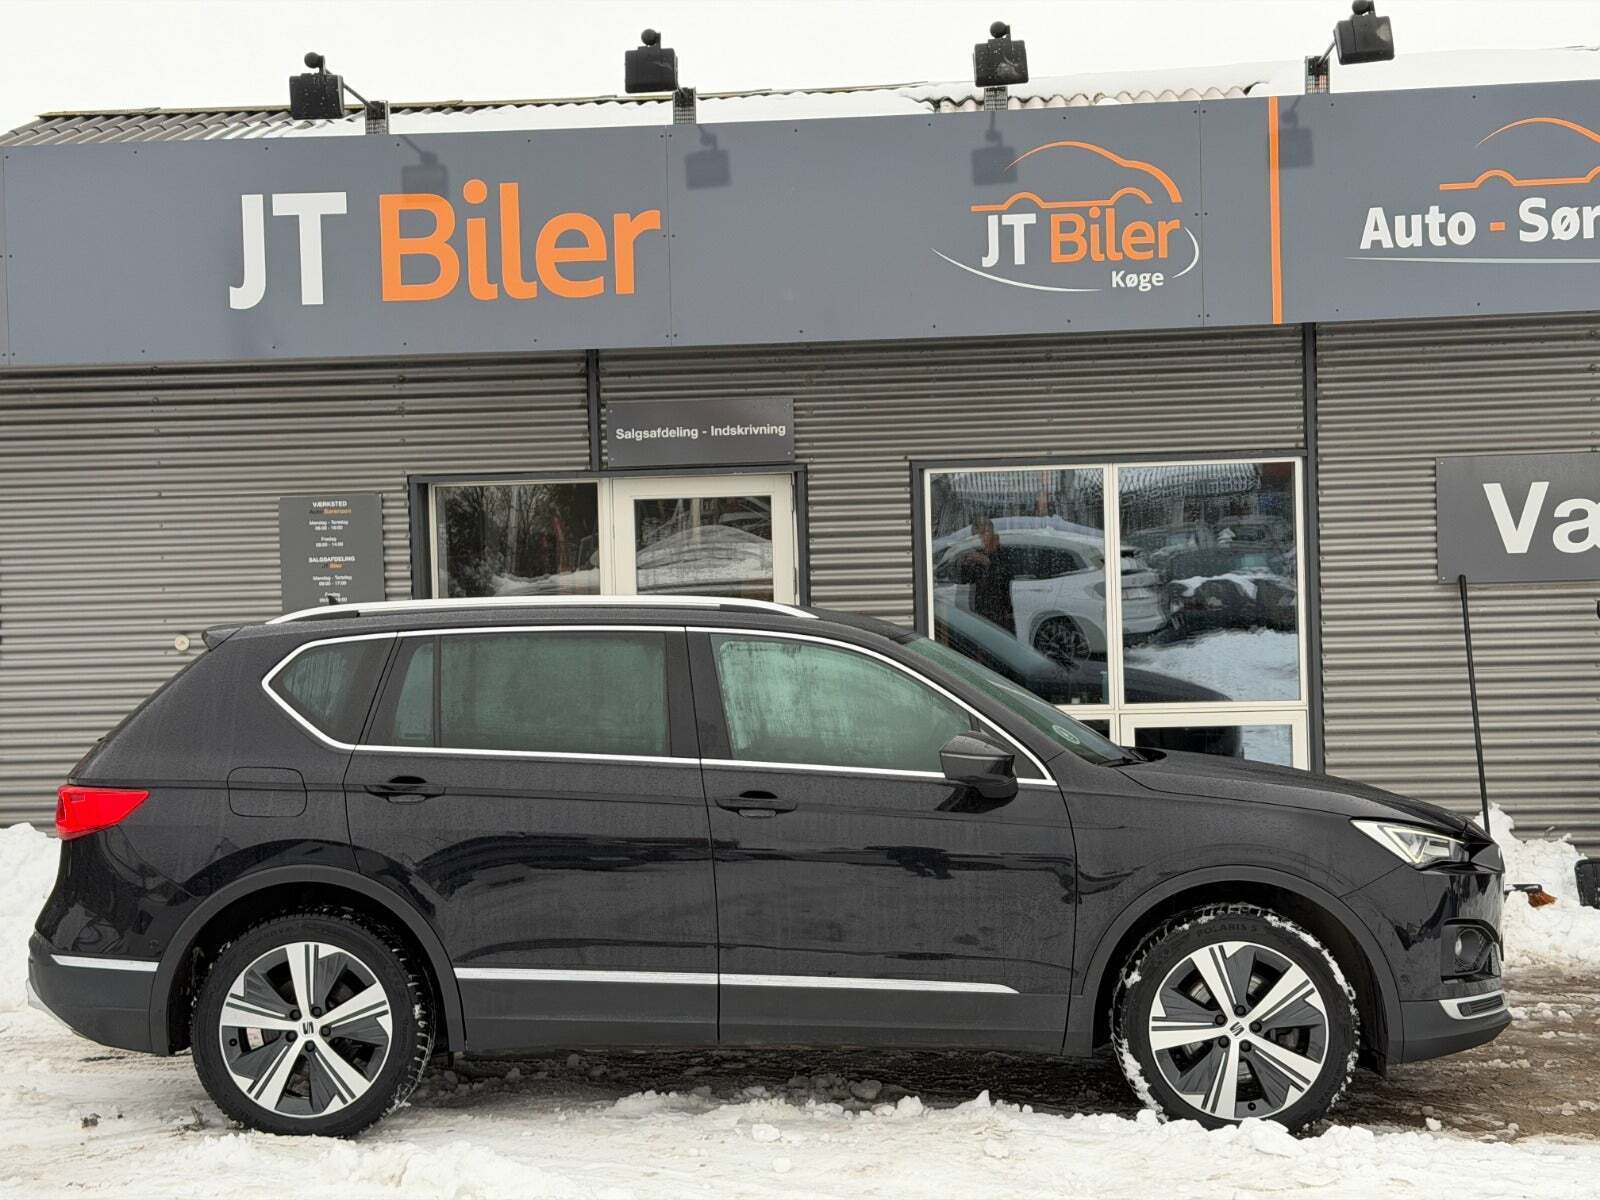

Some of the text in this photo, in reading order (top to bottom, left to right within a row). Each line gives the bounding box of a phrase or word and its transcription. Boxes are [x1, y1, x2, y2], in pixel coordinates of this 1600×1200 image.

[229, 178, 661, 310] JT Biler
[981, 206, 1181, 268] JT Biler
[1359, 205, 1476, 250] Auto
[1111, 269, 1165, 292] Køge
[615, 426, 699, 442] Salgsafdeling
[710, 423, 787, 437] Indskrivning
